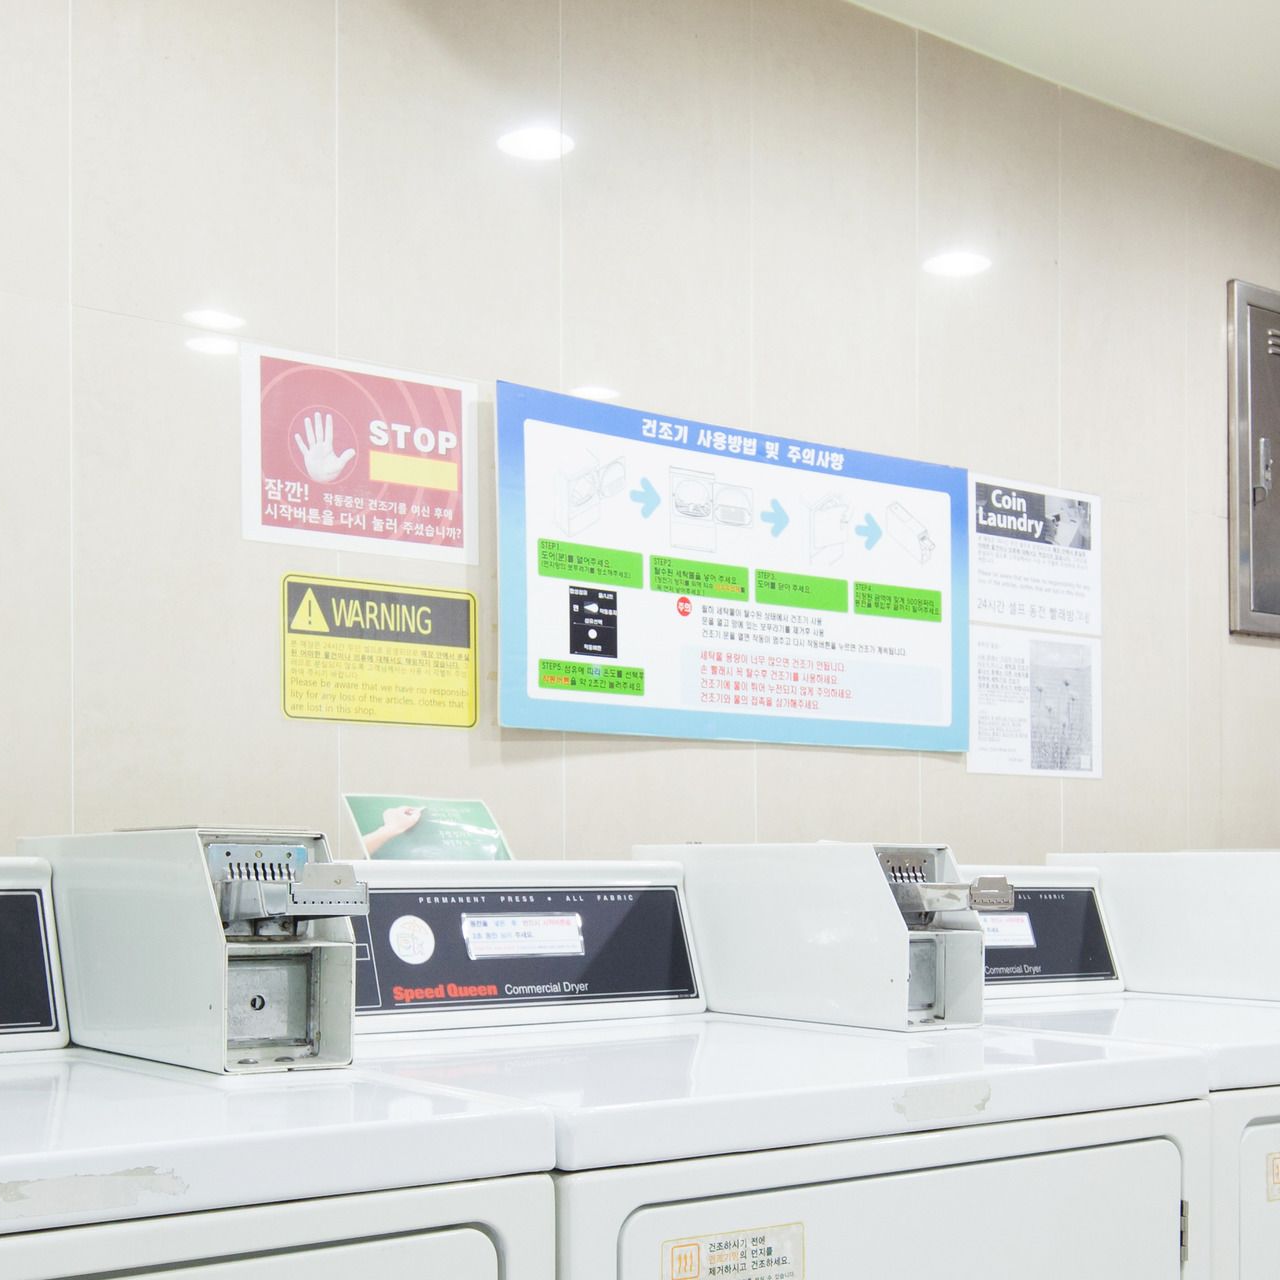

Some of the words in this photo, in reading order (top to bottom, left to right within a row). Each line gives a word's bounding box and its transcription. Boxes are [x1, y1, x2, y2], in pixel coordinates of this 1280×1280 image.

[369, 419, 457, 455] STOP
[642, 418, 688, 444] 건조기
[697, 428, 757, 457] 사용방법
[765, 441, 780, 461] 및
[787, 446, 846, 471] 주의사항
[264, 477, 310, 503] 잠깐!
[323, 493, 364, 510] 작동중인
[367, 499, 407, 515] 건조기를
[991, 488, 1027, 513] Coin
[264, 502, 336, 527] 시작버튼을
[339, 512, 367, 531] 다시
[372, 516, 398, 533] 눌러
[402, 520, 462, 541] 주셨습니까?
[978, 506, 1045, 539] Laundry
[977, 597, 1005, 614] 24시간
[331, 597, 432, 636] WARNING
[726, 652, 748, 664] 용량이
[750, 653, 765, 665] 너무
[362, 681, 379, 691] that
[394, 684, 413, 694] have
[307, 702, 323, 712] lost
[336, 703, 352, 714] this
[369, 692, 382, 703] the
[418, 696, 447, 708] clothes
[418, 895, 487, 904] PERMANENT
[499, 895, 535, 903] PRESS
[565, 894, 585, 902] ALL
[596, 893, 634, 902] FABRIC
[985, 964, 1024, 975] Commercial
[1023, 963, 1042, 974] Dryer
[392, 983, 445, 1004] Speed
[446, 982, 498, 998] Queen
[504, 981, 561, 996] Commercial
[563, 980, 589, 995] Dryer
[708, 1239, 748, 1253] 건조하시기
[708, 1261, 748, 1276] 제거하시고
